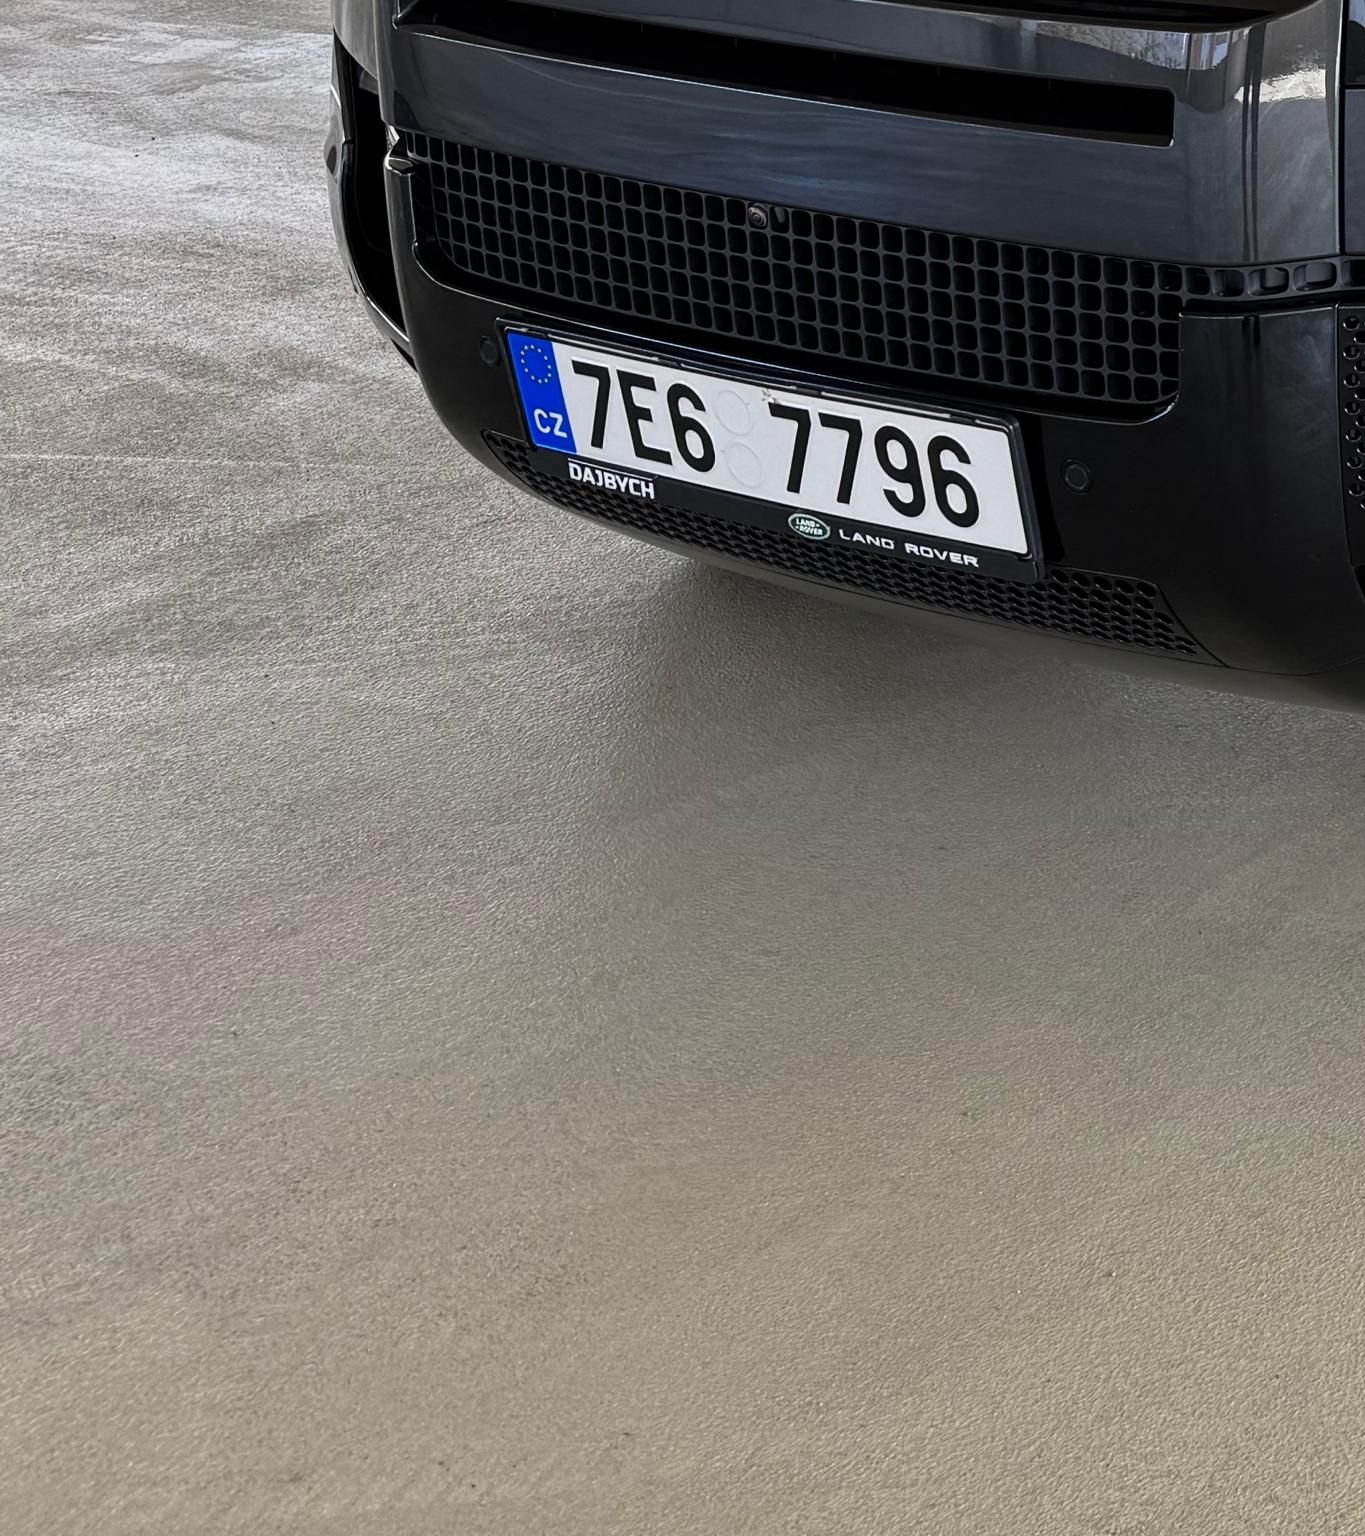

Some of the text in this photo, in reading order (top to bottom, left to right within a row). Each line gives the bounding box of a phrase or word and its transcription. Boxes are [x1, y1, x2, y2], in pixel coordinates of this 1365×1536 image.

[533, 406, 568, 440] CZ
[571, 359, 981, 529] 7E6 7796
[568, 462, 656, 501] DAJBYCH
[796, 517, 816, 528] LAND
[799, 525, 823, 536] ROVER
[839, 528, 980, 568] LAND ROVER
